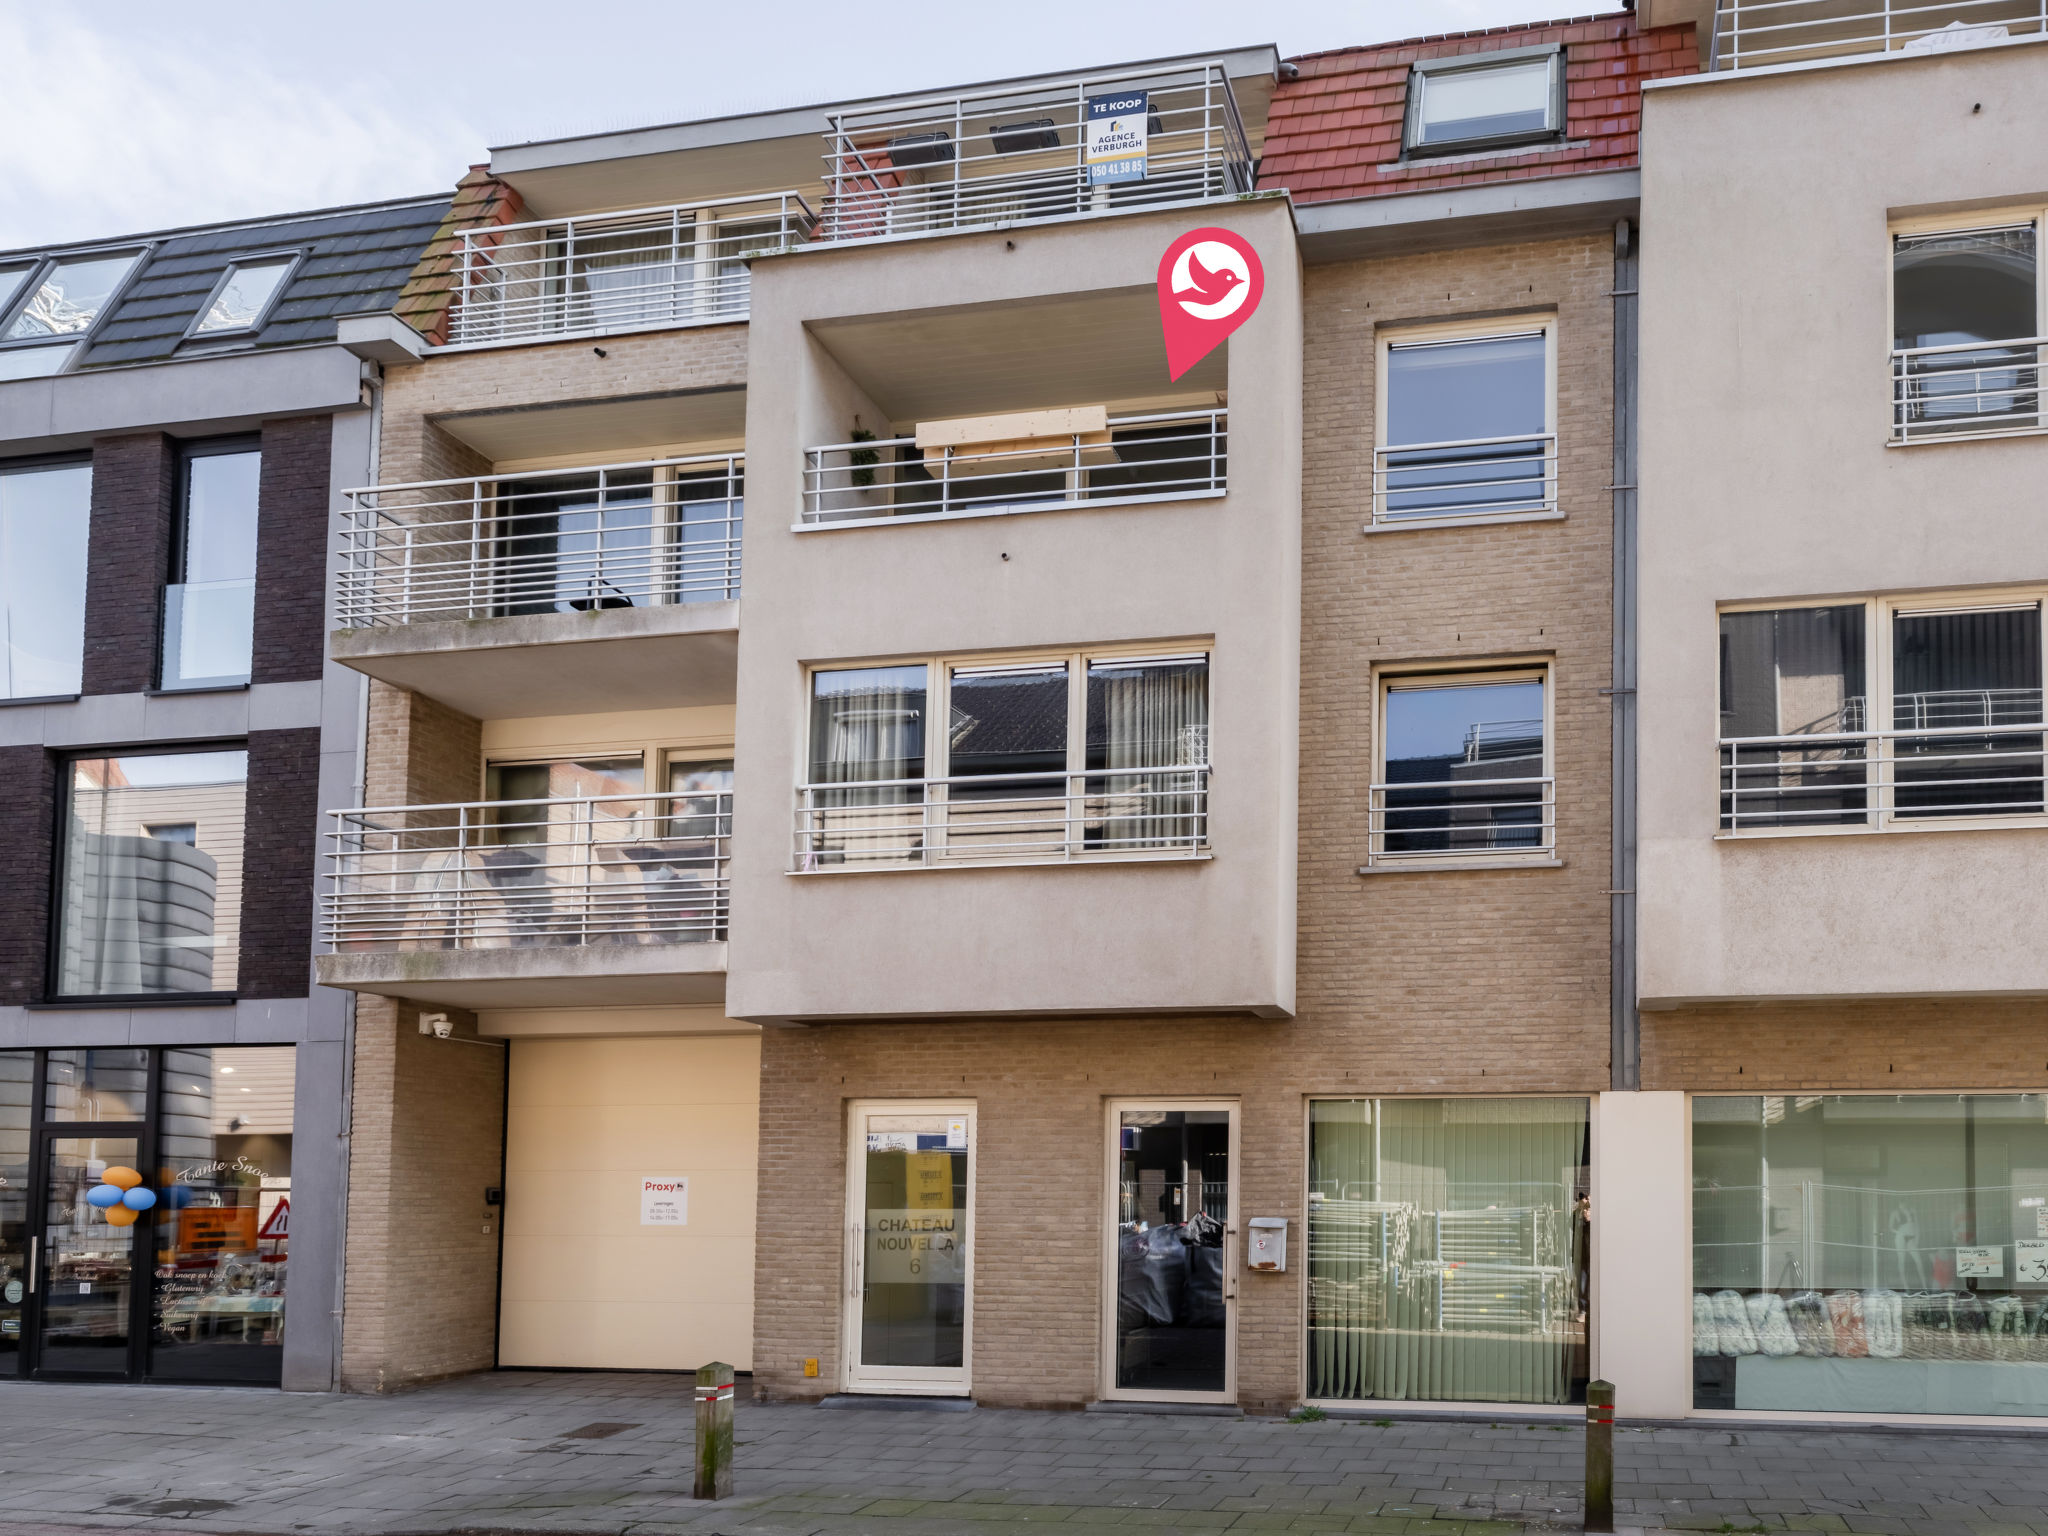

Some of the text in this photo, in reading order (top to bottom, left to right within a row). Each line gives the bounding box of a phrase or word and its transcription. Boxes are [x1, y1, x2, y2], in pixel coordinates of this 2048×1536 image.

[1093, 99, 1142, 113] TE KOOP
[1098, 132, 1136, 144] AGENCE
[1091, 140, 1142, 153] VERBURGH
[1091, 164, 1107, 176] 050
[1108, 163, 1119, 175] 41
[176, 1156, 271, 1184] Tante Snoe
[645, 1181, 675, 1193] Proxy
[878, 1218, 955, 1232] CHATEAU
[910, 1258, 921, 1275] 6
[160, 1322, 186, 1335] Vegan
